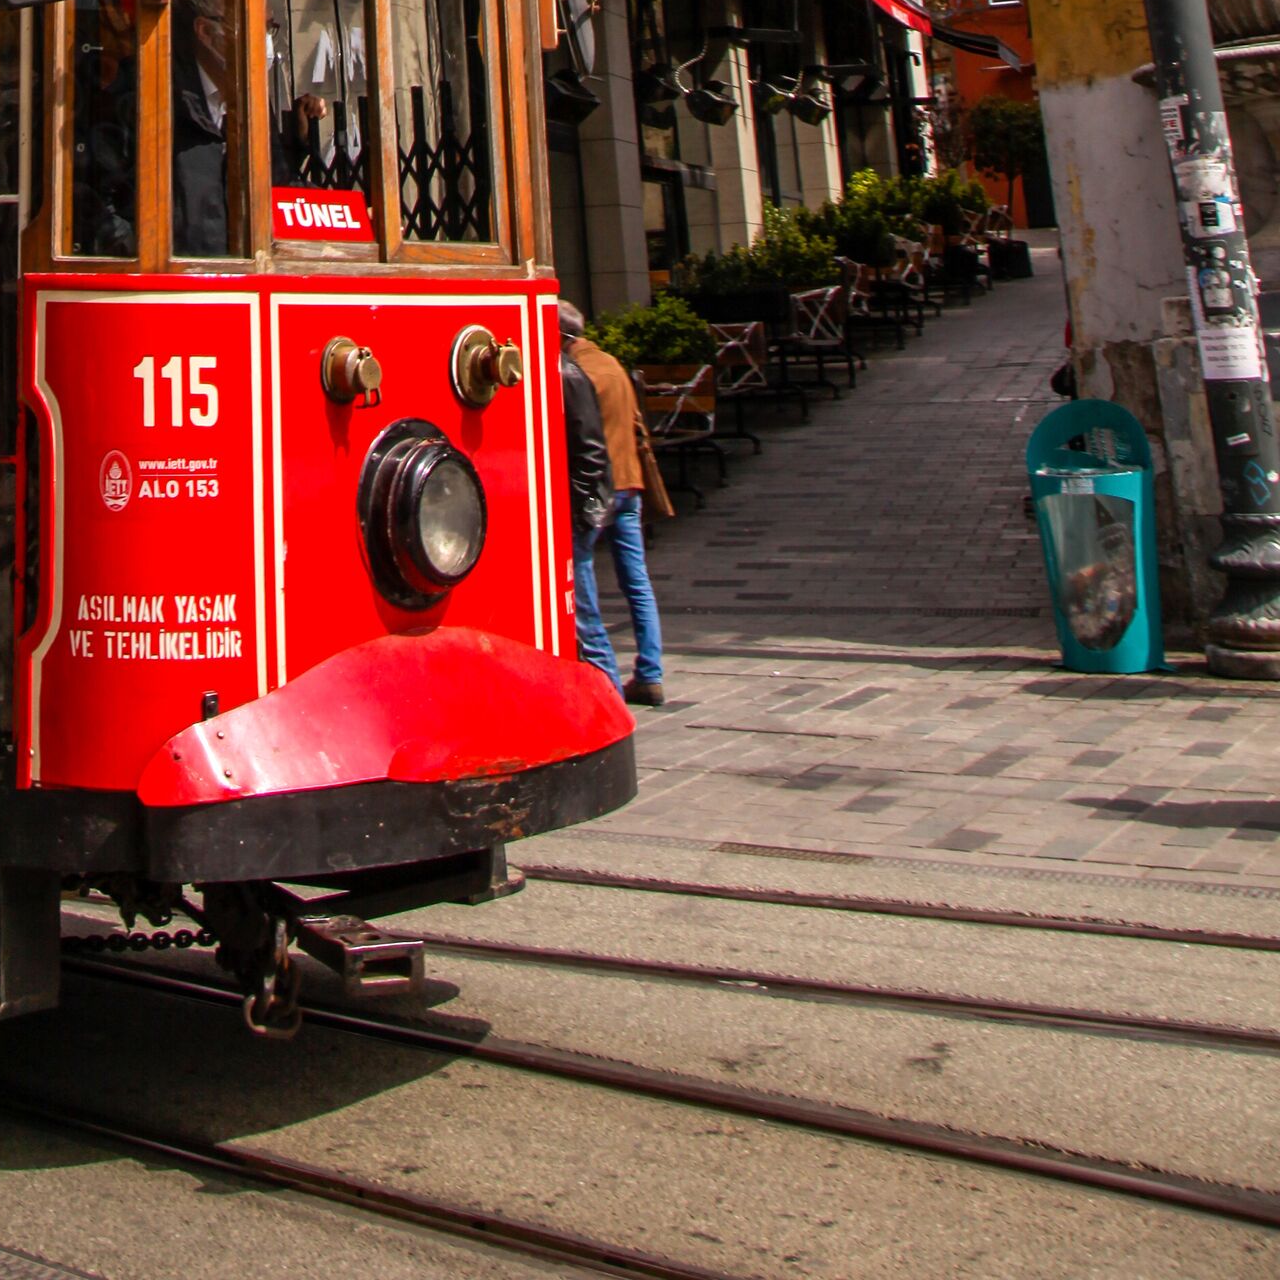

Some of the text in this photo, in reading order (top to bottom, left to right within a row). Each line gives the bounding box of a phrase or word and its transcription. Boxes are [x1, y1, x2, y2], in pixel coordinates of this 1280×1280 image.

[277, 197, 361, 229] TÜNEL
[133, 356, 219, 427] 115
[138, 458, 218, 472] www.iett.gov.tr
[138, 479, 220, 498] ALO 153
[78, 593, 237, 624] ASILMAK YASAK
[69, 626, 242, 660] VE TEHLİKELİDİR
